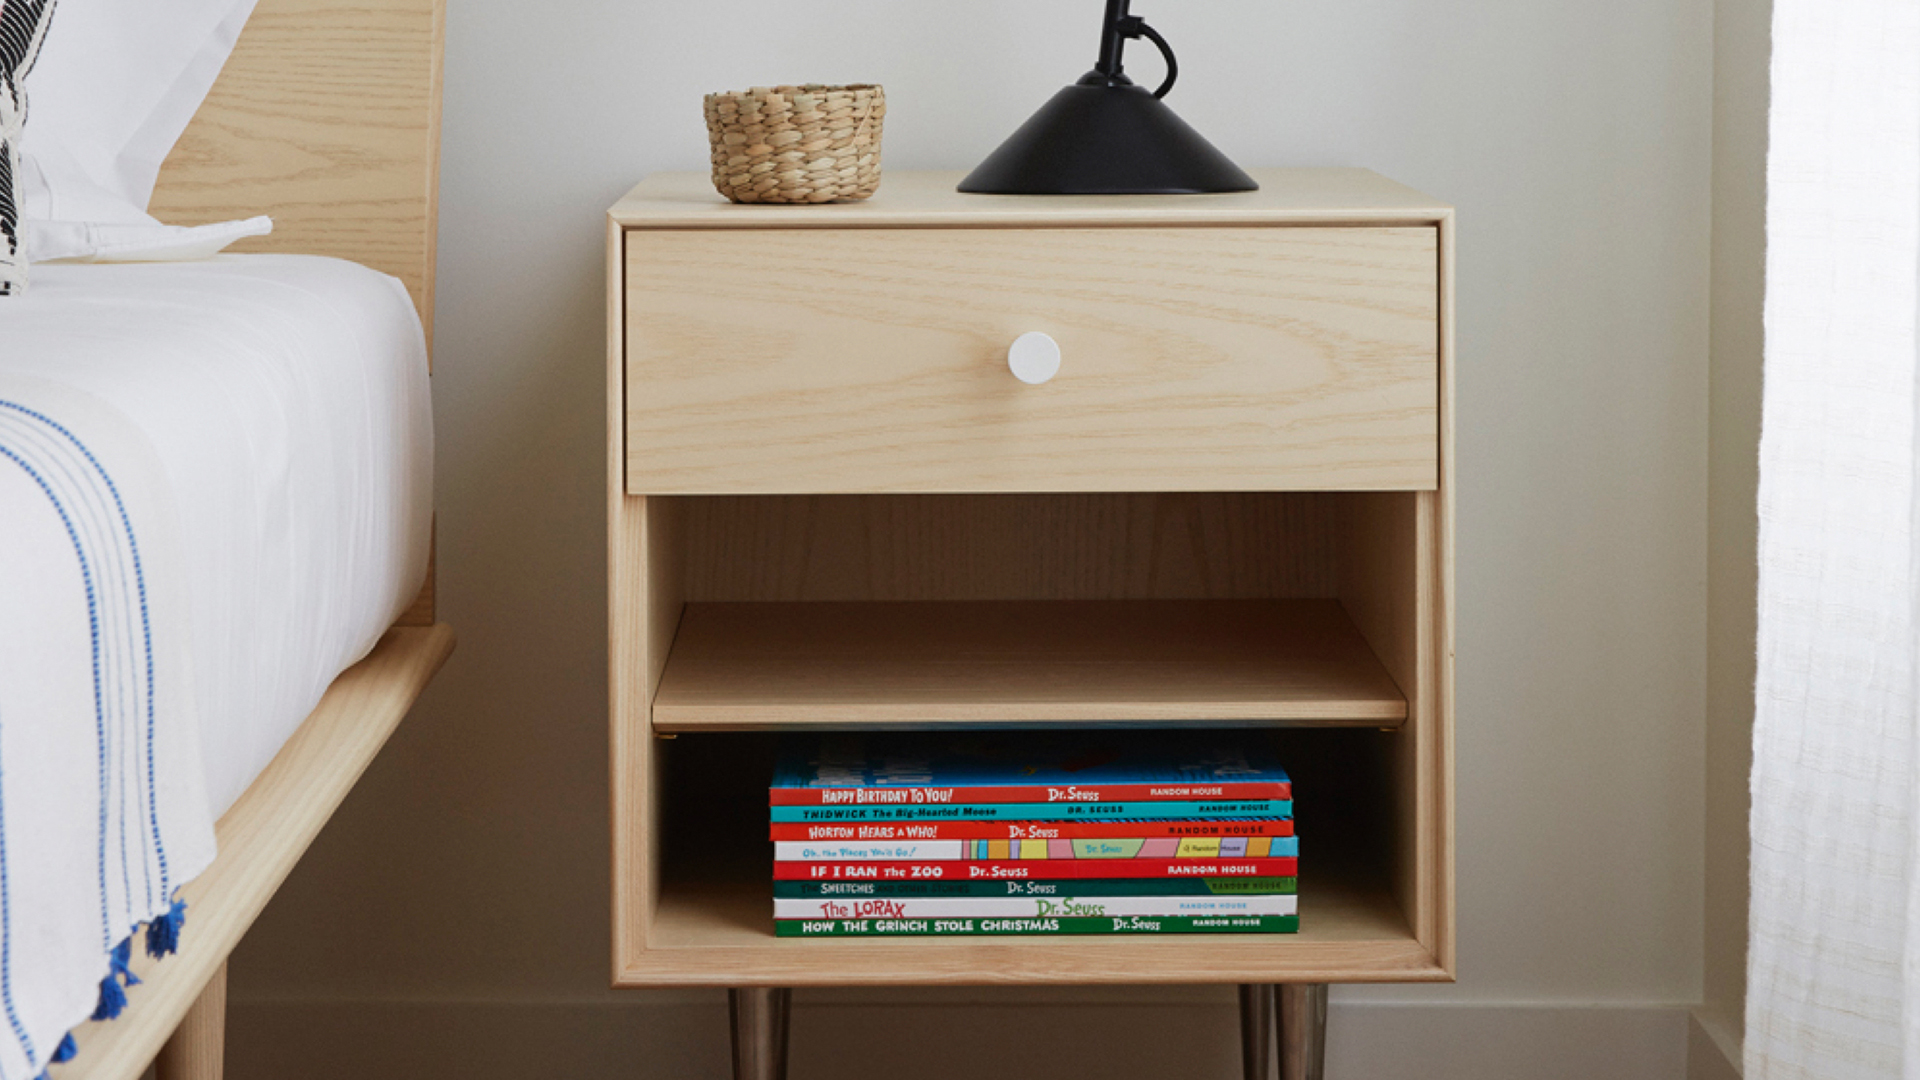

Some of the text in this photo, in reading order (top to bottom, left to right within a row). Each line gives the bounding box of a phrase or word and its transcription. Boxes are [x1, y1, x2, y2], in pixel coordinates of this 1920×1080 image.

[822, 788, 855, 803] HAPPY
[857, 788, 908, 803] BIRTHDAY
[925, 788, 954, 803] YOU!
[1047, 786, 1099, 801] Dr. Seuss
[1150, 787, 1223, 796] RANDOM HOUSE
[803, 807, 997, 819] THIDWICK The Big-Hearted Moose
[1067, 805, 1123, 814] DR. SEUSS
[1199, 804, 1270, 813] RANDOM HOUSE
[808, 826, 854, 839] HORTON
[858, 826, 895, 838] HEARS
[906, 826, 938, 839] WHO!
[1008, 825, 1059, 838] Dr. Seuss
[1224, 826, 1264, 834] HOUSE
[895, 846, 917, 857] Go!
[1085, 843, 1123, 854] Dr. Seuss
[810, 866, 943, 877] IF I RAN The ZOO
[969, 866, 1028, 877] Dr. Seuss
[1167, 864, 1257, 875] RANDOM HOUSE
[1007, 881, 1056, 894] Dr. Seuss
[820, 900, 906, 919] The LORAX
[1035, 897, 1105, 917] Dr. Seuss
[802, 919, 1060, 933] HOW THE GRINCH STOLE CHRISTMAS
[1112, 916, 1161, 930] Dr. Seuss
[1232, 918, 1261, 926] HOUSE
